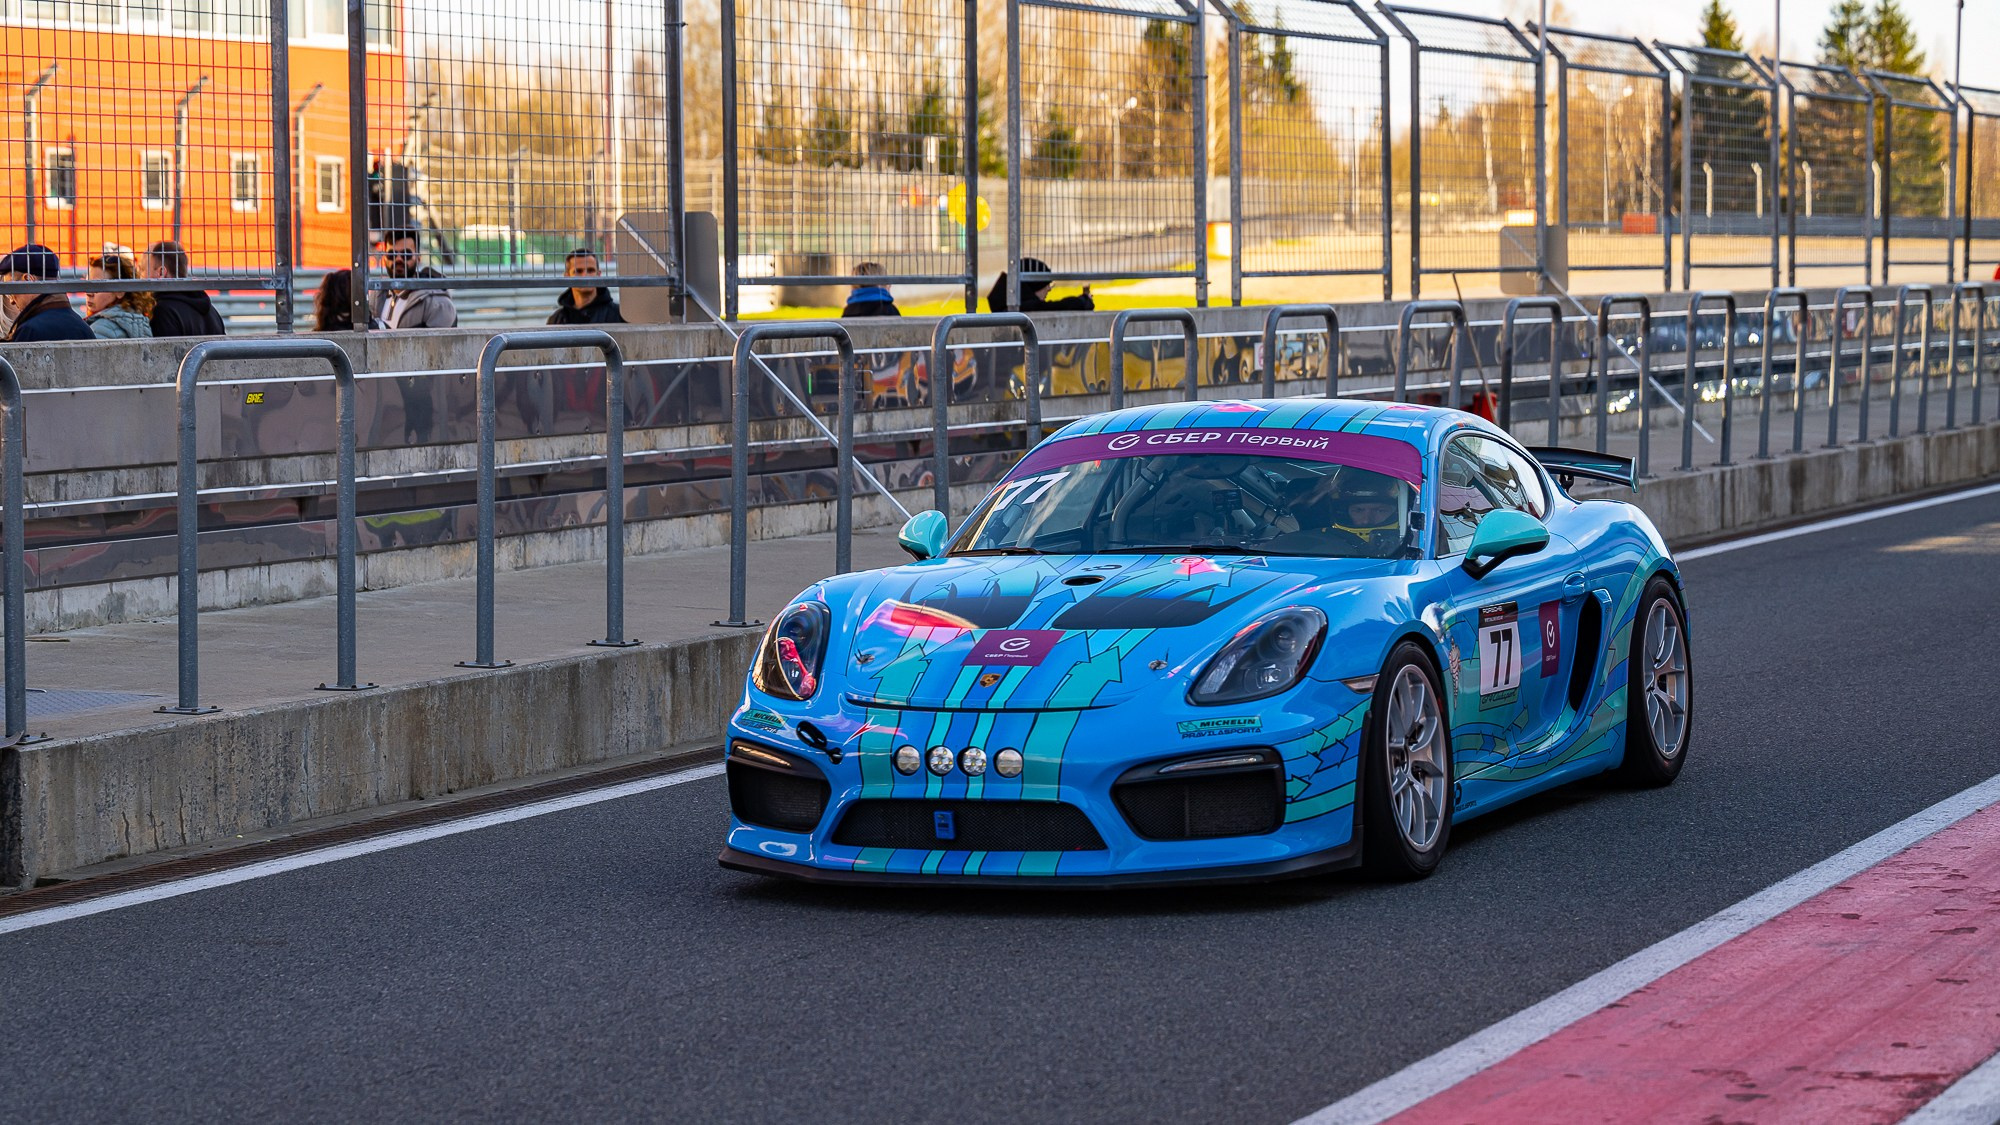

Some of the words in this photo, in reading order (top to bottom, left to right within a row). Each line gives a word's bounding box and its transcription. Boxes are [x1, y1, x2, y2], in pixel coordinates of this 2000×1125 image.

[1146, 432, 1222, 446] СБЕР
[1226, 432, 1329, 450] Первый
[993, 471, 1071, 512] 77
[1489, 628, 1513, 688] 77
[1199, 718, 1256, 727] MICHELIN
[1181, 727, 1262, 739] PRAVILASPORTA
